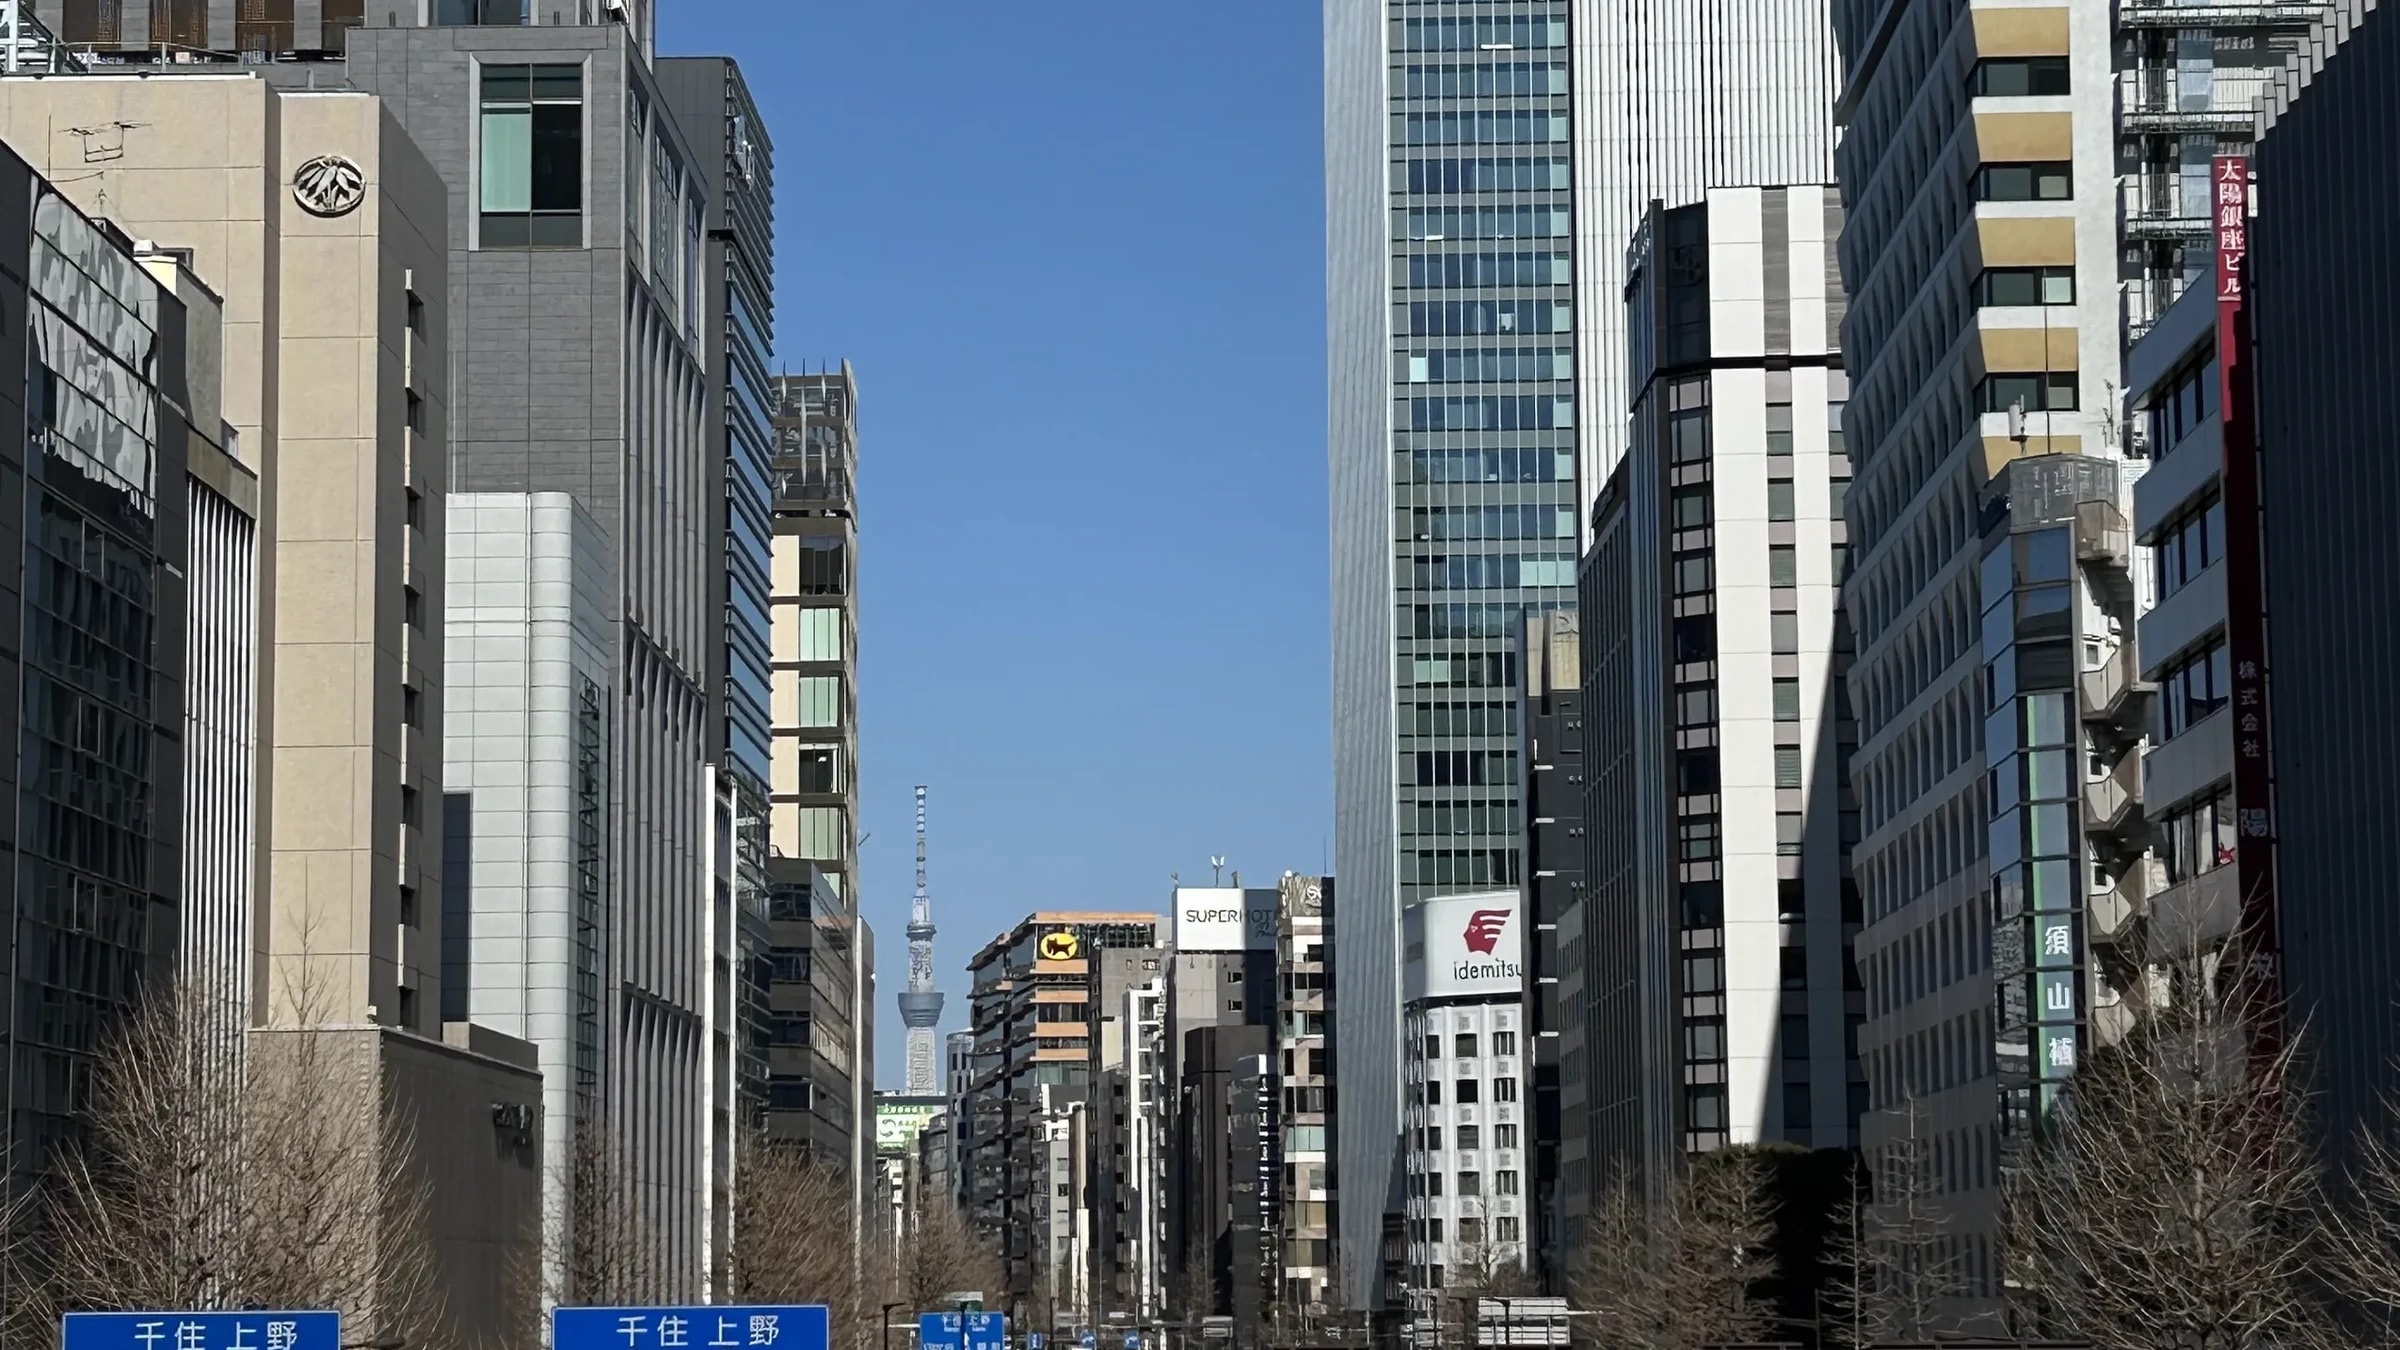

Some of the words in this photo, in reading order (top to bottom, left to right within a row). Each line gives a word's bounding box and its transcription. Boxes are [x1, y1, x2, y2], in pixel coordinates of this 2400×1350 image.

[134, 1321, 207, 1350] 千住
[226, 1321, 298, 1350] 上野
[616, 1315, 689, 1347] 千住
[708, 1315, 780, 1346] 上野
